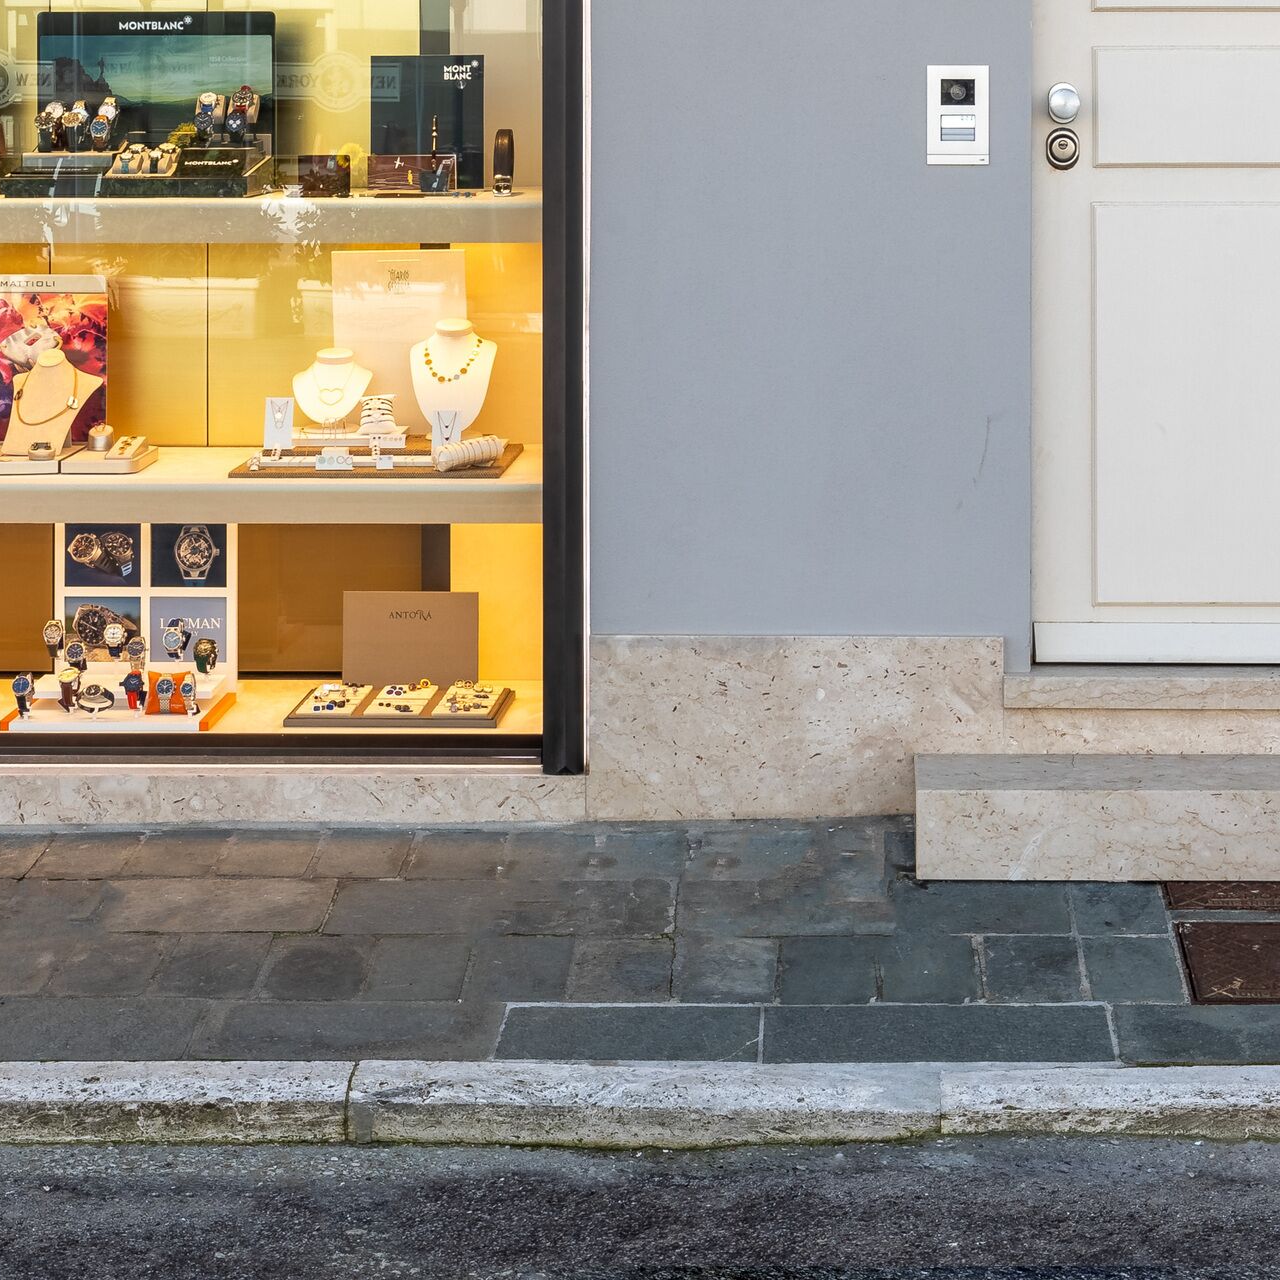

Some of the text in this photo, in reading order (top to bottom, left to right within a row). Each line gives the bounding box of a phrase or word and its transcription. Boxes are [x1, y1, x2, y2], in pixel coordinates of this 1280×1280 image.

[118, 21, 184, 30] MONTBLANC
[443, 64, 472, 73] MONT
[443, 72, 472, 80] BLANC
[0, 280, 56, 288] MATTIOLI
